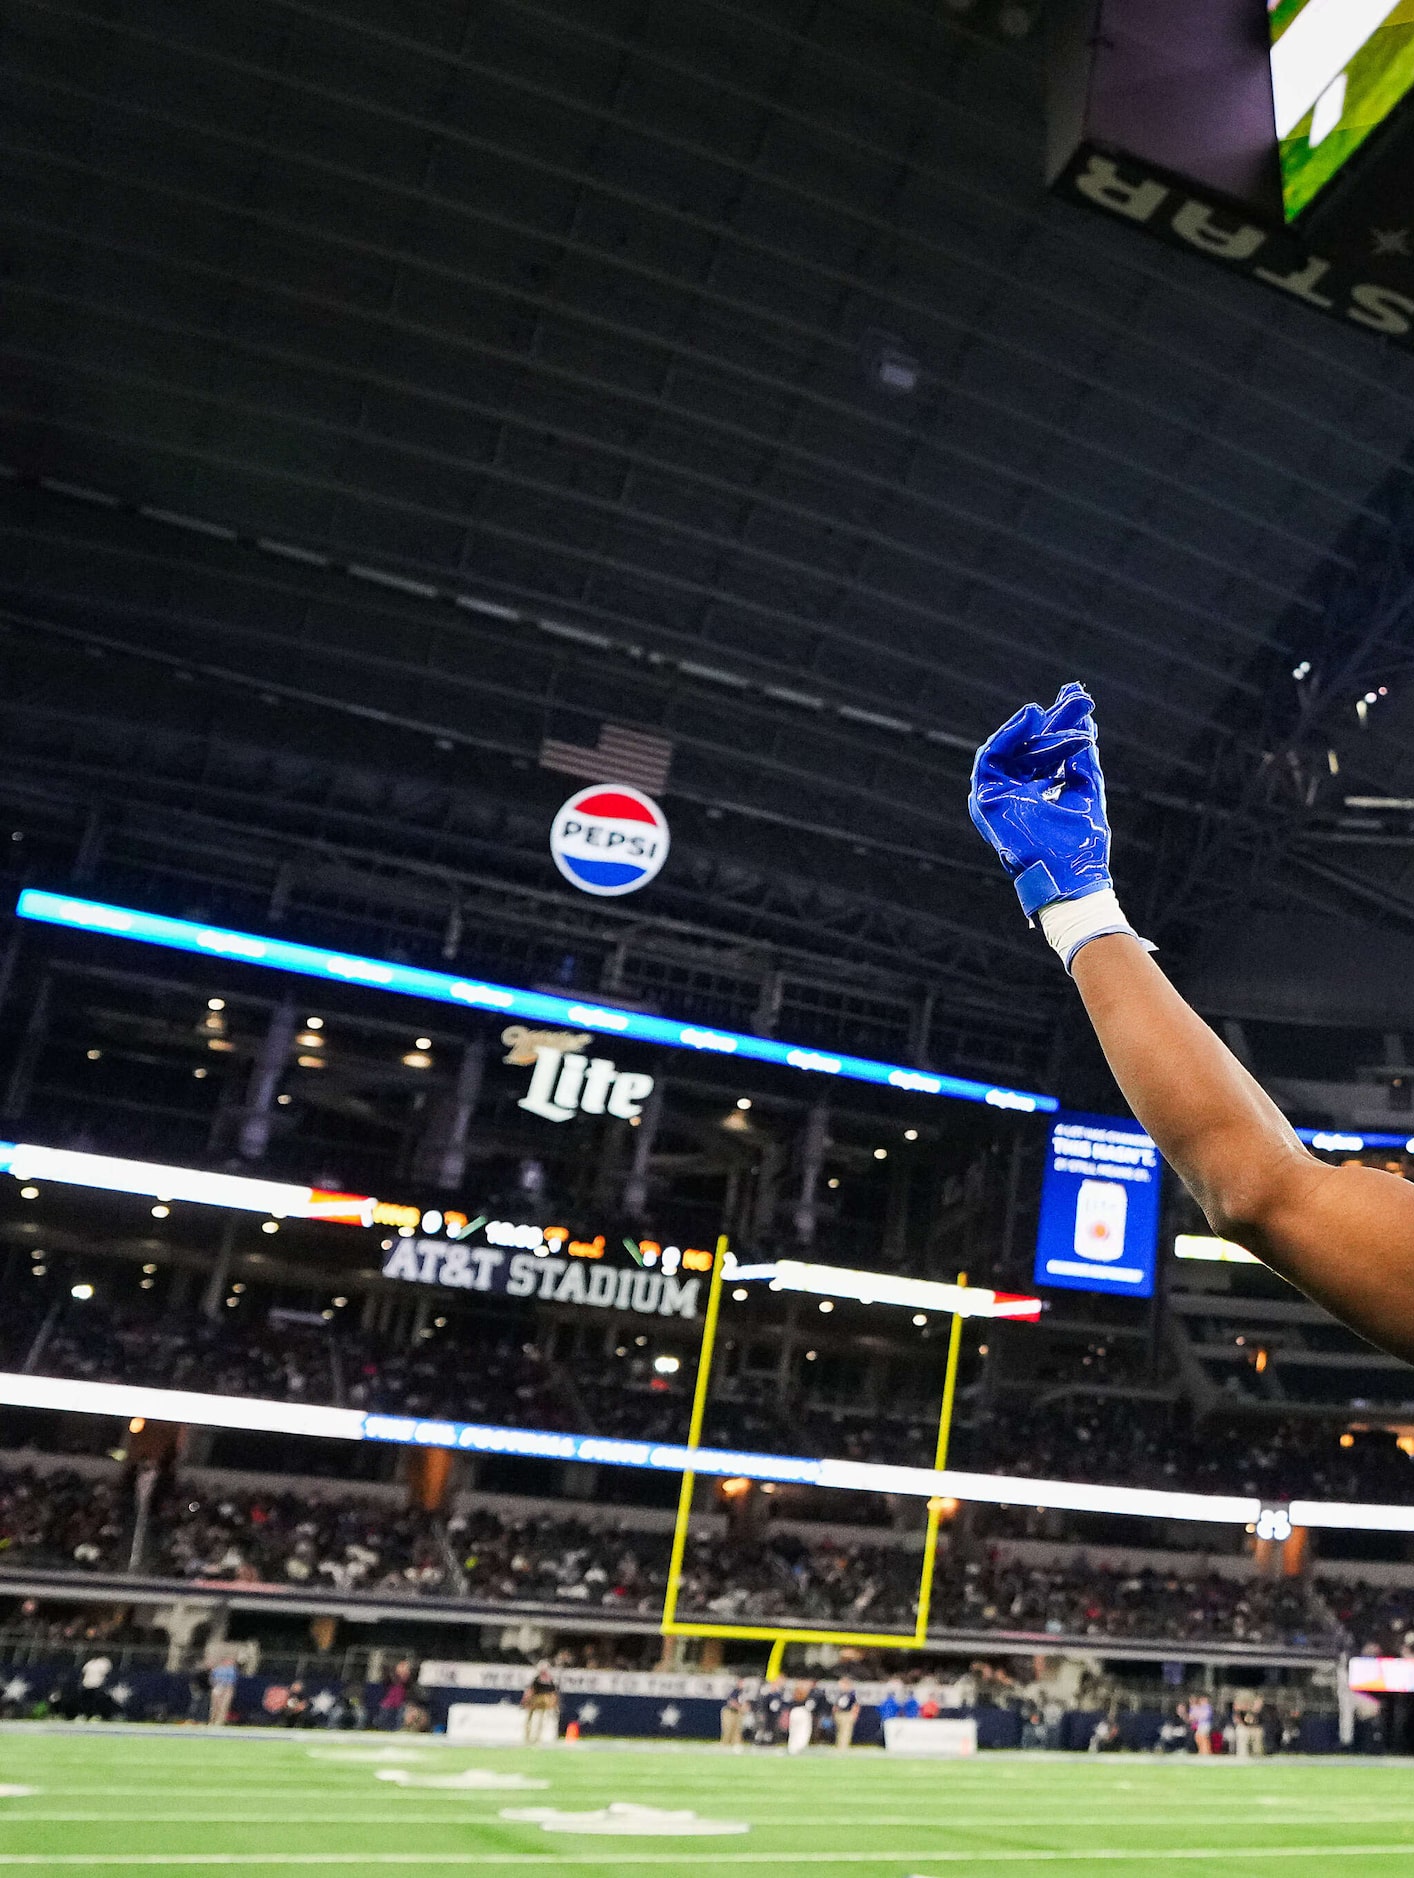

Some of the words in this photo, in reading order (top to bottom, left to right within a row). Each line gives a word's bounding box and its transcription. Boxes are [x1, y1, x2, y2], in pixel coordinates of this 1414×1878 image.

[562, 821, 657, 859] PEPSI
[517, 1046, 654, 1122] Lite
[383, 1236, 504, 1292] AT&T
[506, 1253, 700, 1319] STADIUM
